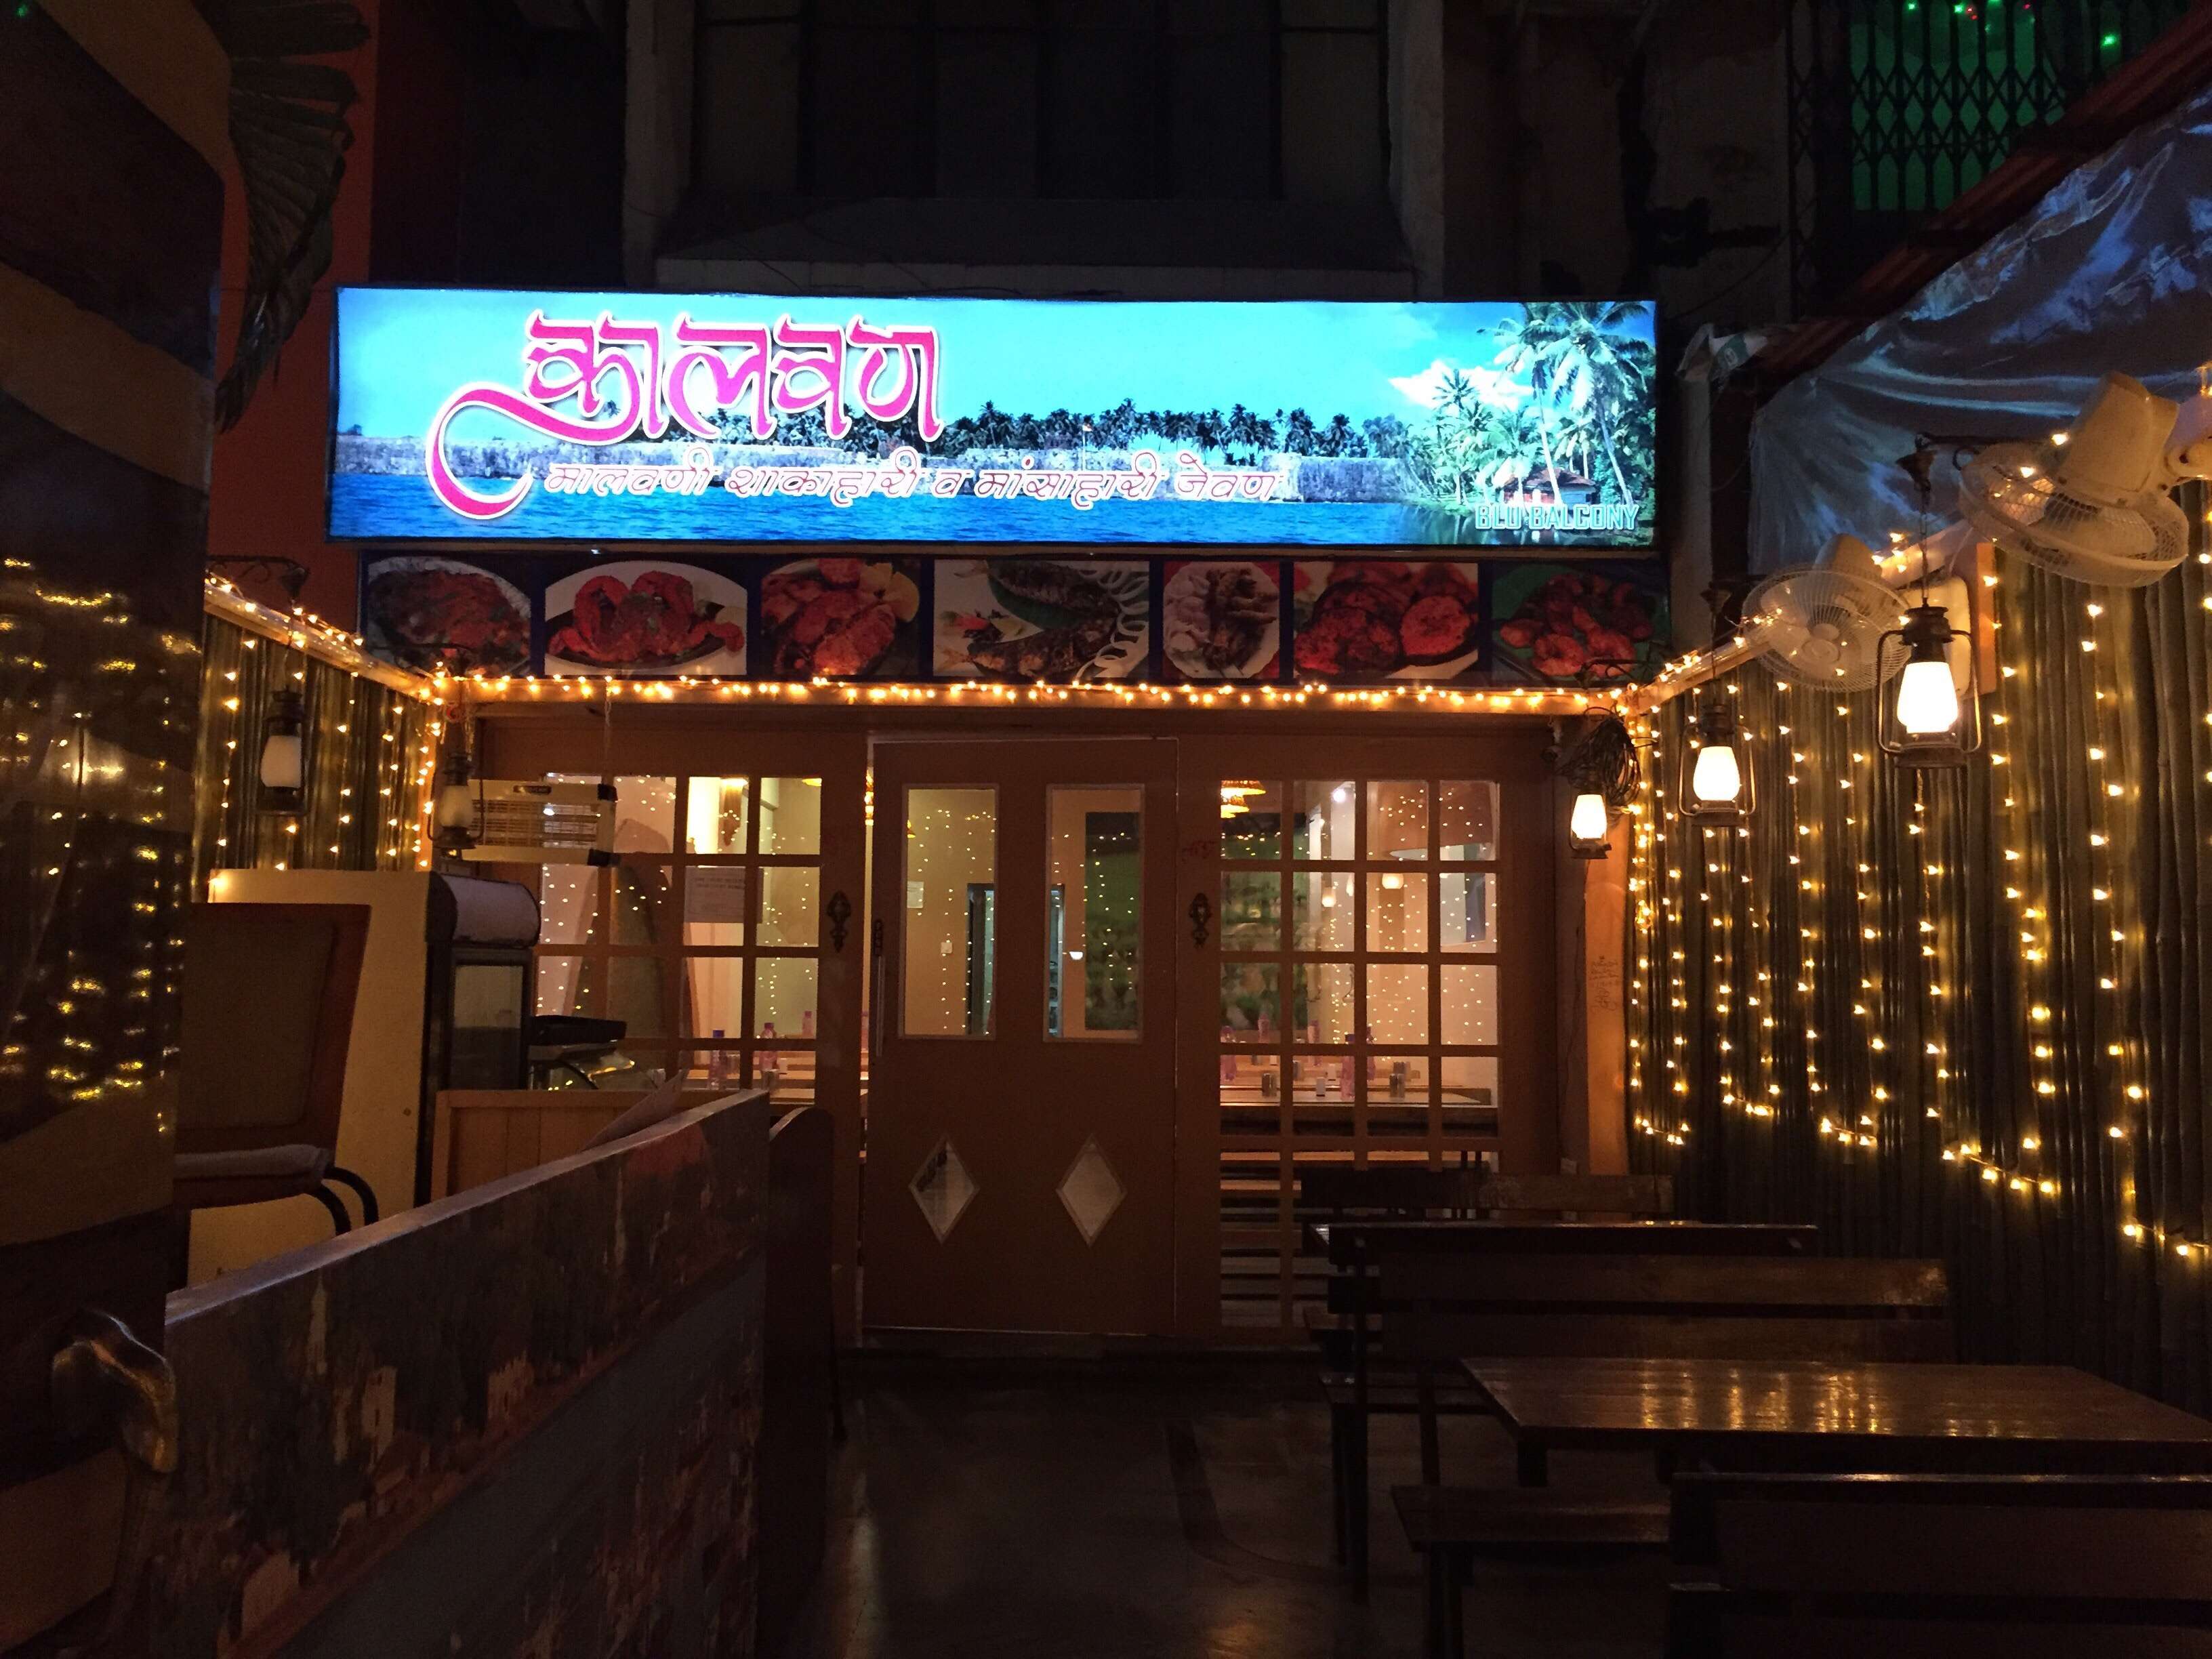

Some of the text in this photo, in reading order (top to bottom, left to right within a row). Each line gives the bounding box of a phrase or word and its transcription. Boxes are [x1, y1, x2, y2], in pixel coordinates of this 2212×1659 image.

[426, 311, 943, 519] कालवण
[544, 445, 1284, 510] मालवणी शाकाहारी व मांसाहारी जेवण
[1475, 504, 1639, 529] BLU BALCONY
